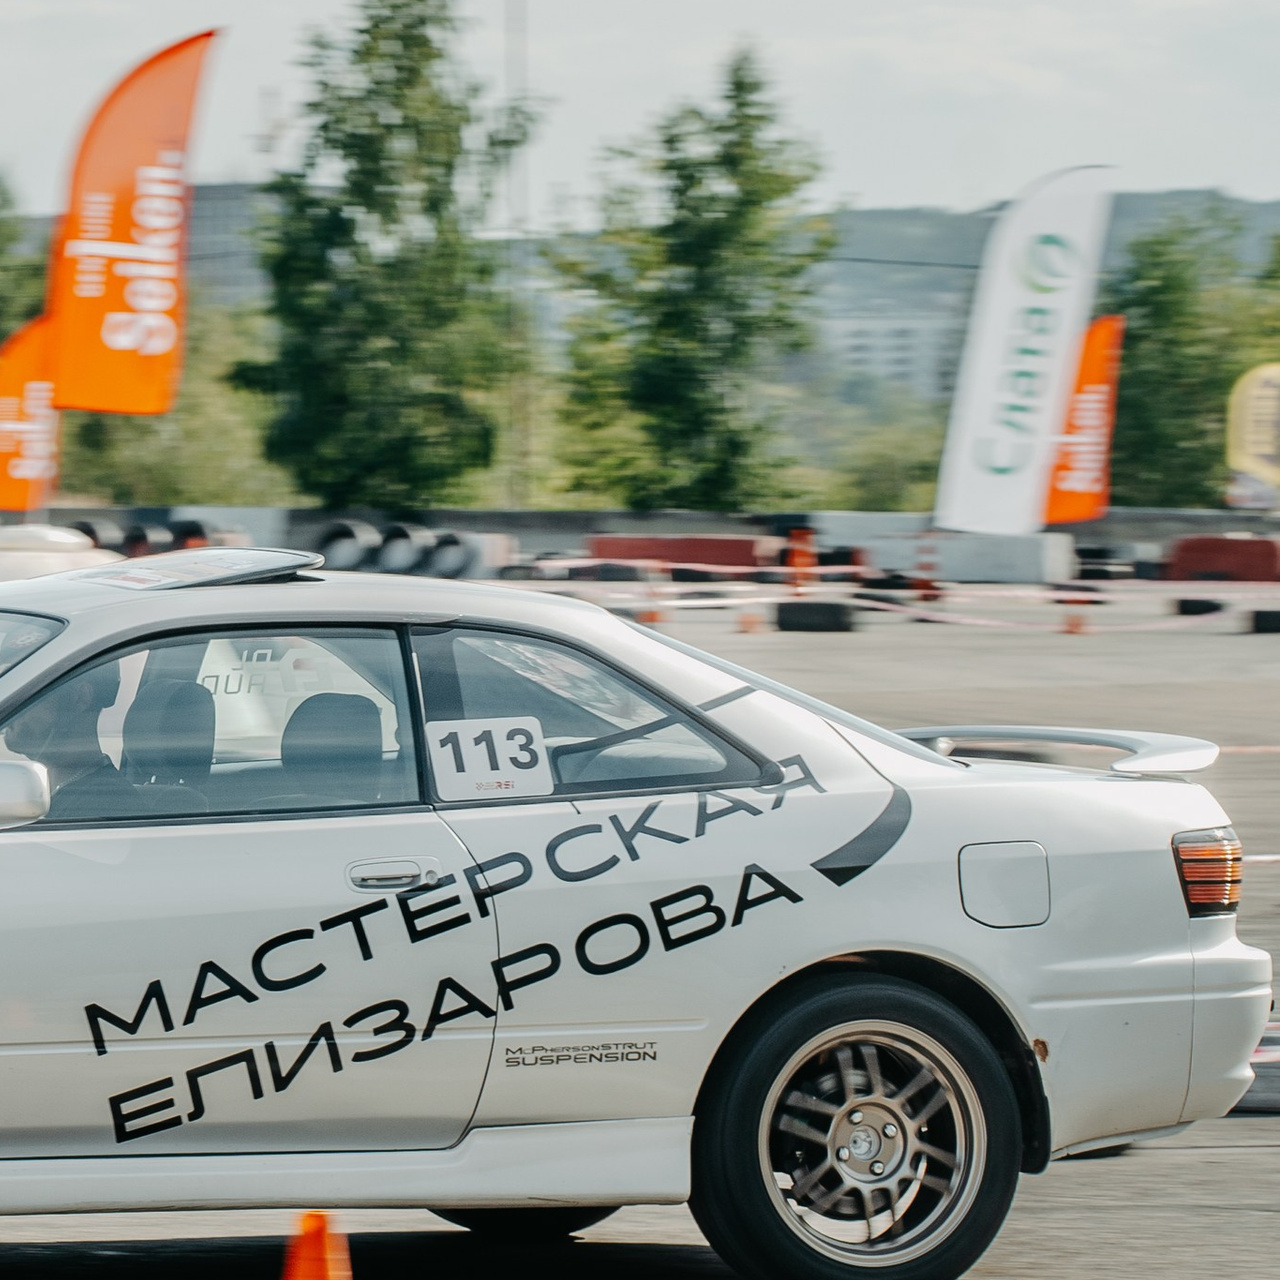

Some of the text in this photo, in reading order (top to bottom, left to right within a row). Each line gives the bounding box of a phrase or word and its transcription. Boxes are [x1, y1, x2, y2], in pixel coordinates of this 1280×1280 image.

[439, 727, 539, 773] 113
[84, 754, 828, 1057] МАСТЕРСКАЯ
[108, 862, 804, 1144] ЕЛИЗАРОВА
[505, 1051, 658, 1068] SUSPENSION
